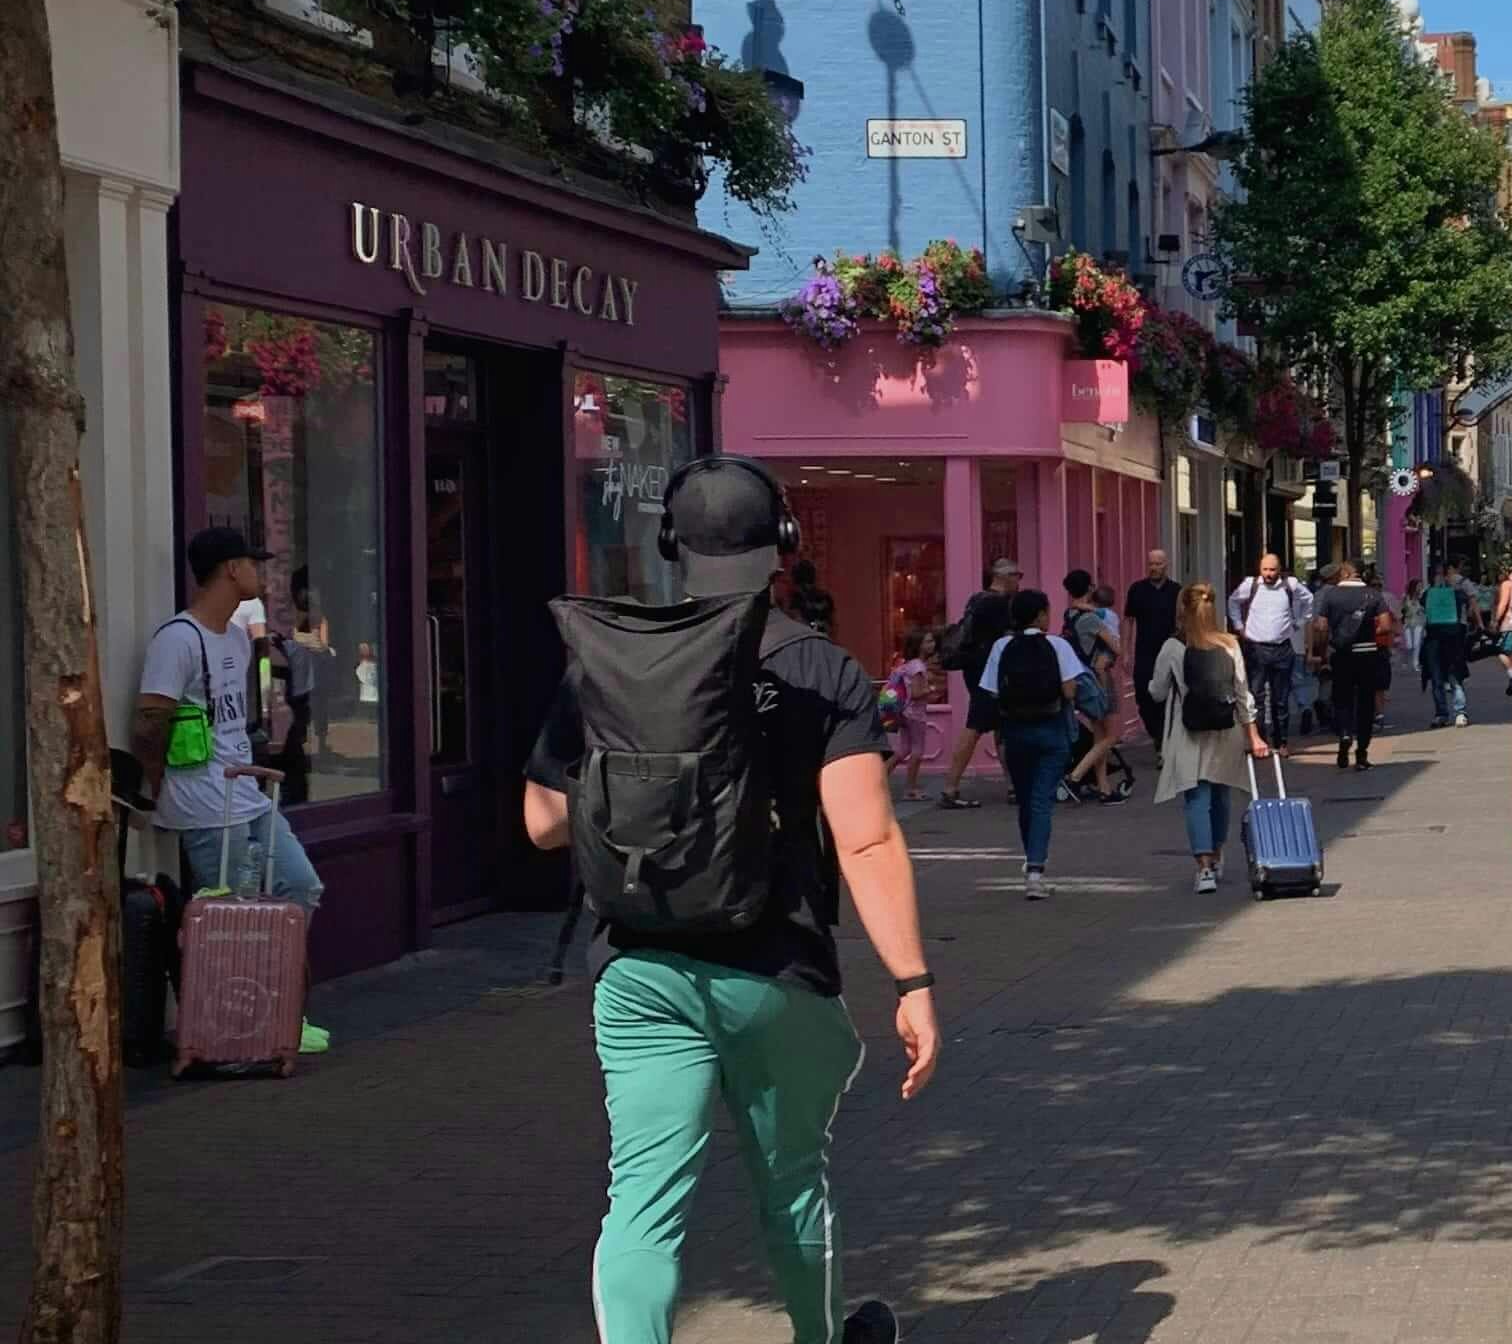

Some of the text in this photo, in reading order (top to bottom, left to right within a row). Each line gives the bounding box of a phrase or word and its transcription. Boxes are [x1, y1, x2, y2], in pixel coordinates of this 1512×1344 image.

[871, 131, 961, 146] GANTON ST
[352, 202, 638, 325] URBAN DECAY
